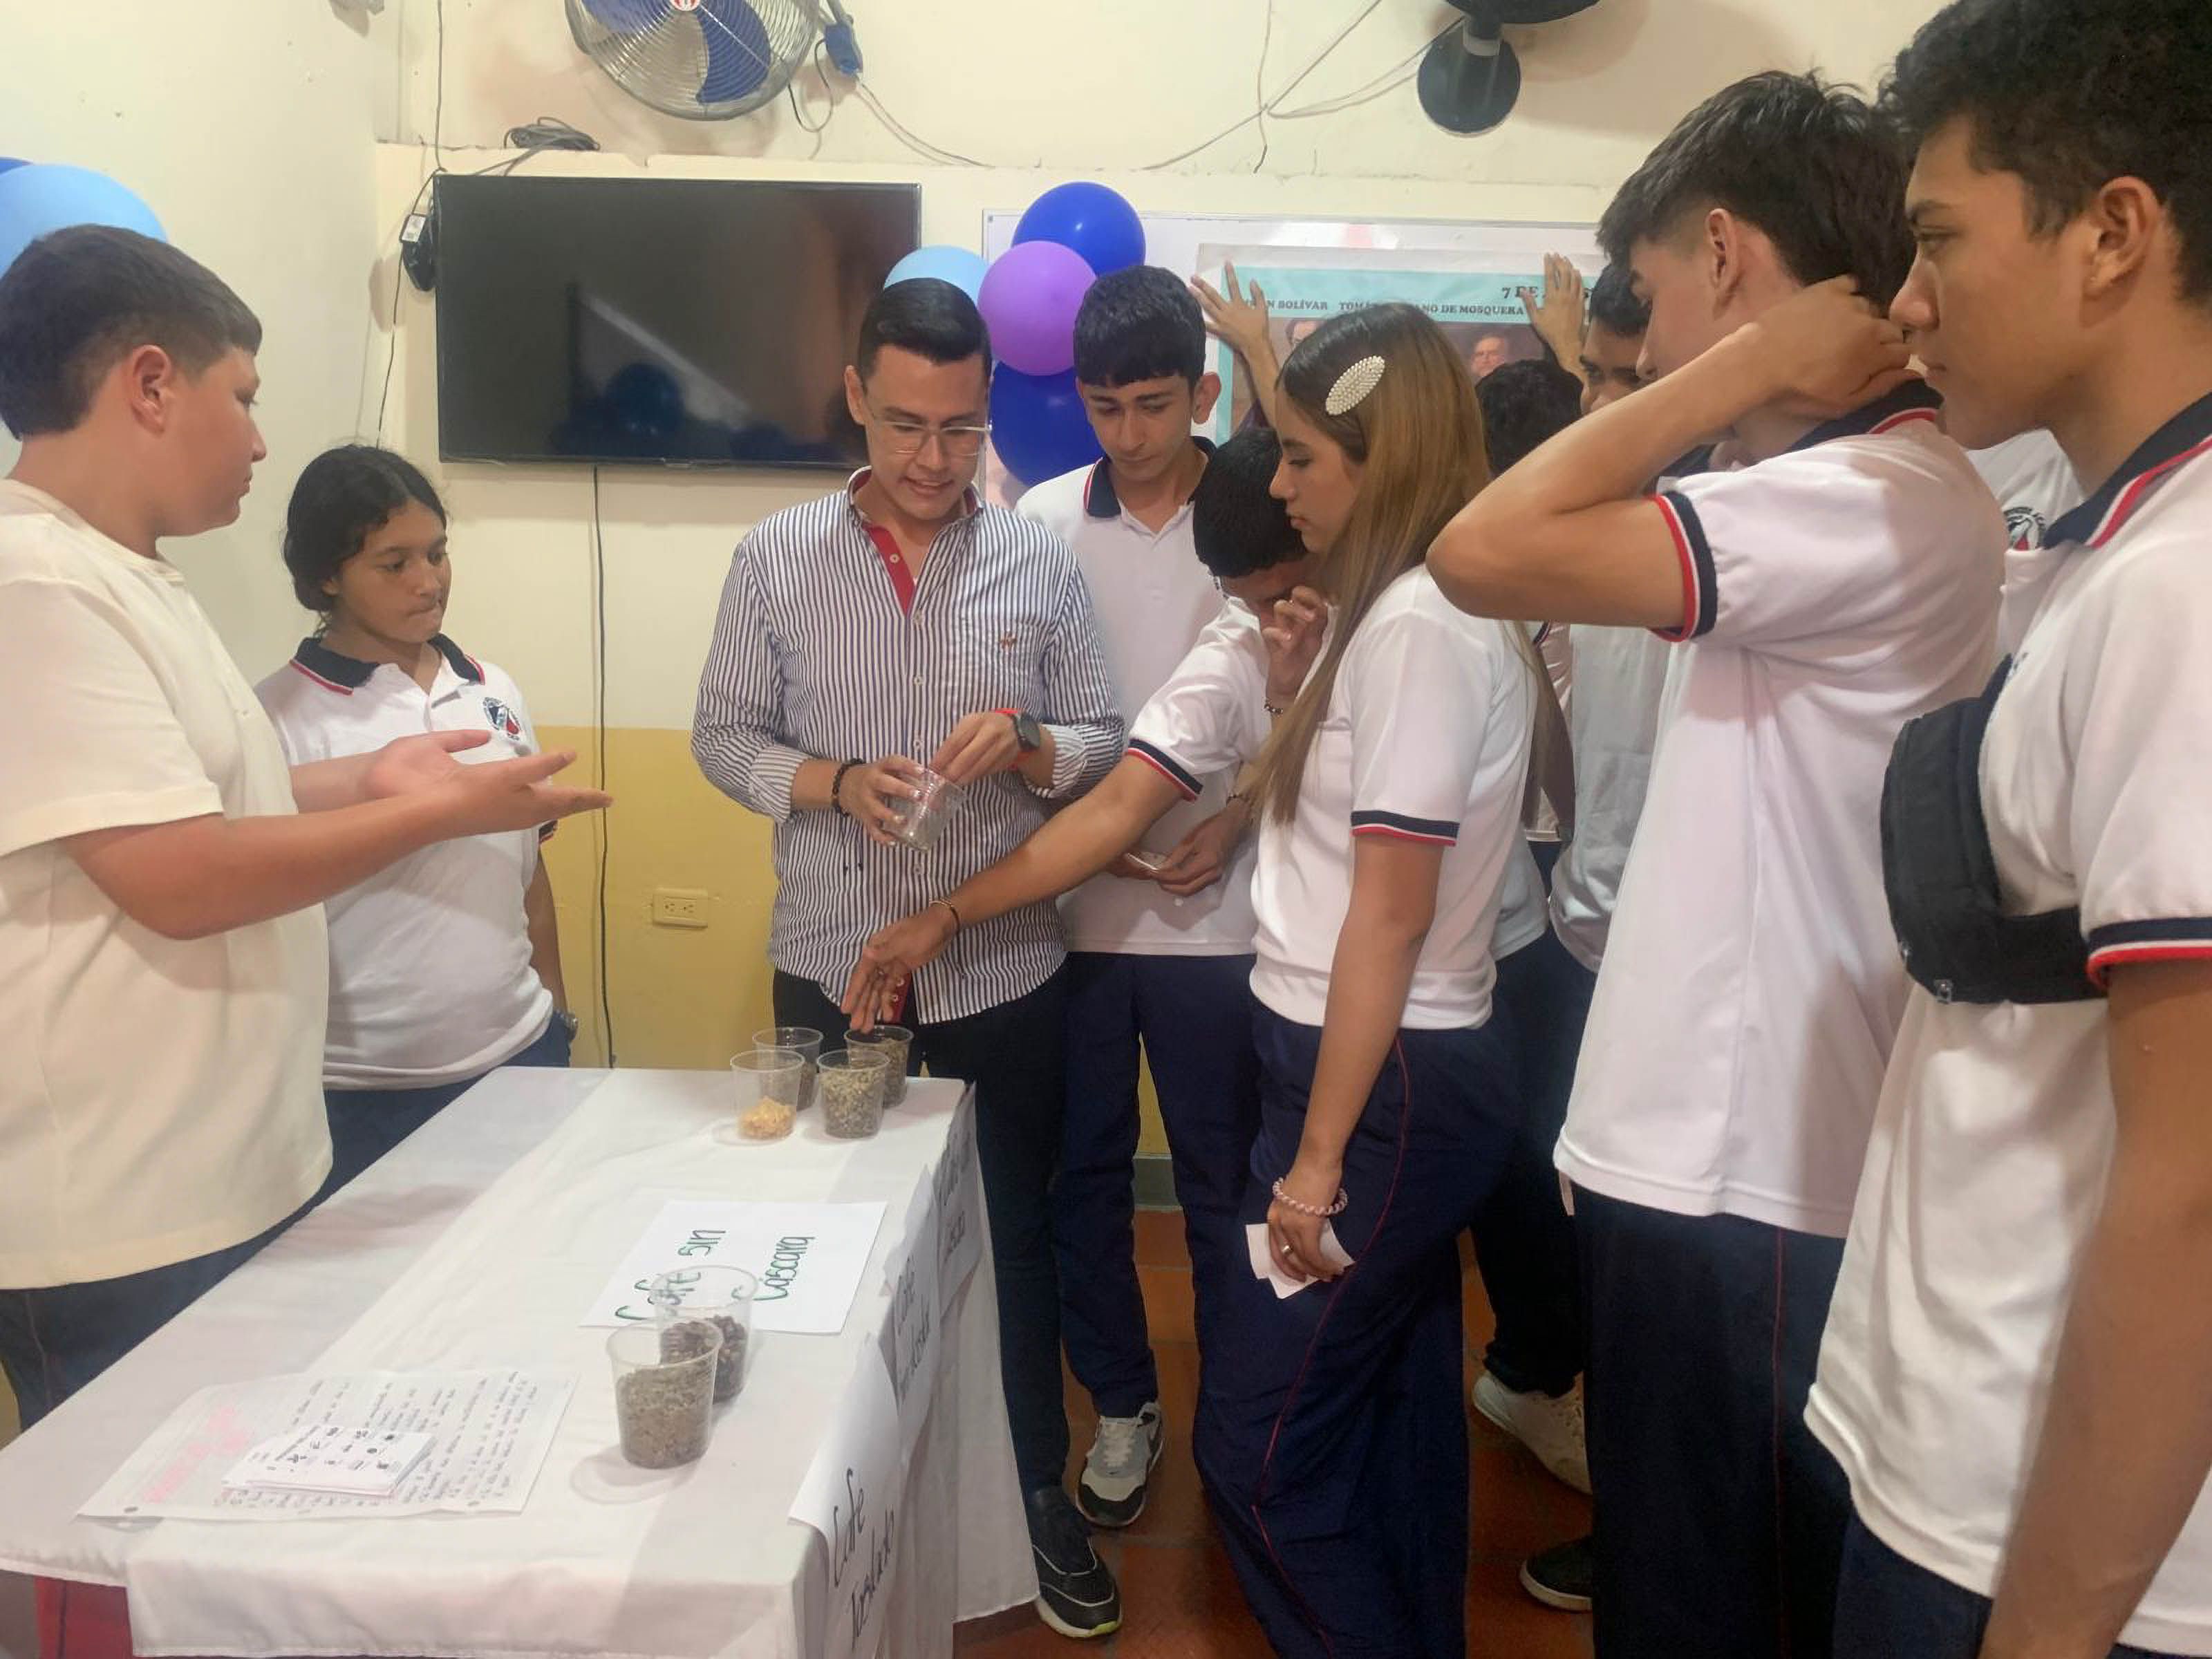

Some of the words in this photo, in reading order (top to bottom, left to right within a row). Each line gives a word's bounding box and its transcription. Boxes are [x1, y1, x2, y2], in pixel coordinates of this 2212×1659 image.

[1502, 287, 1511, 299] 7
[1278, 299, 1328, 310] BOLÍVAR
[1441, 305, 1456, 314] DE
[1459, 305, 1524, 315] MOSQUERA
